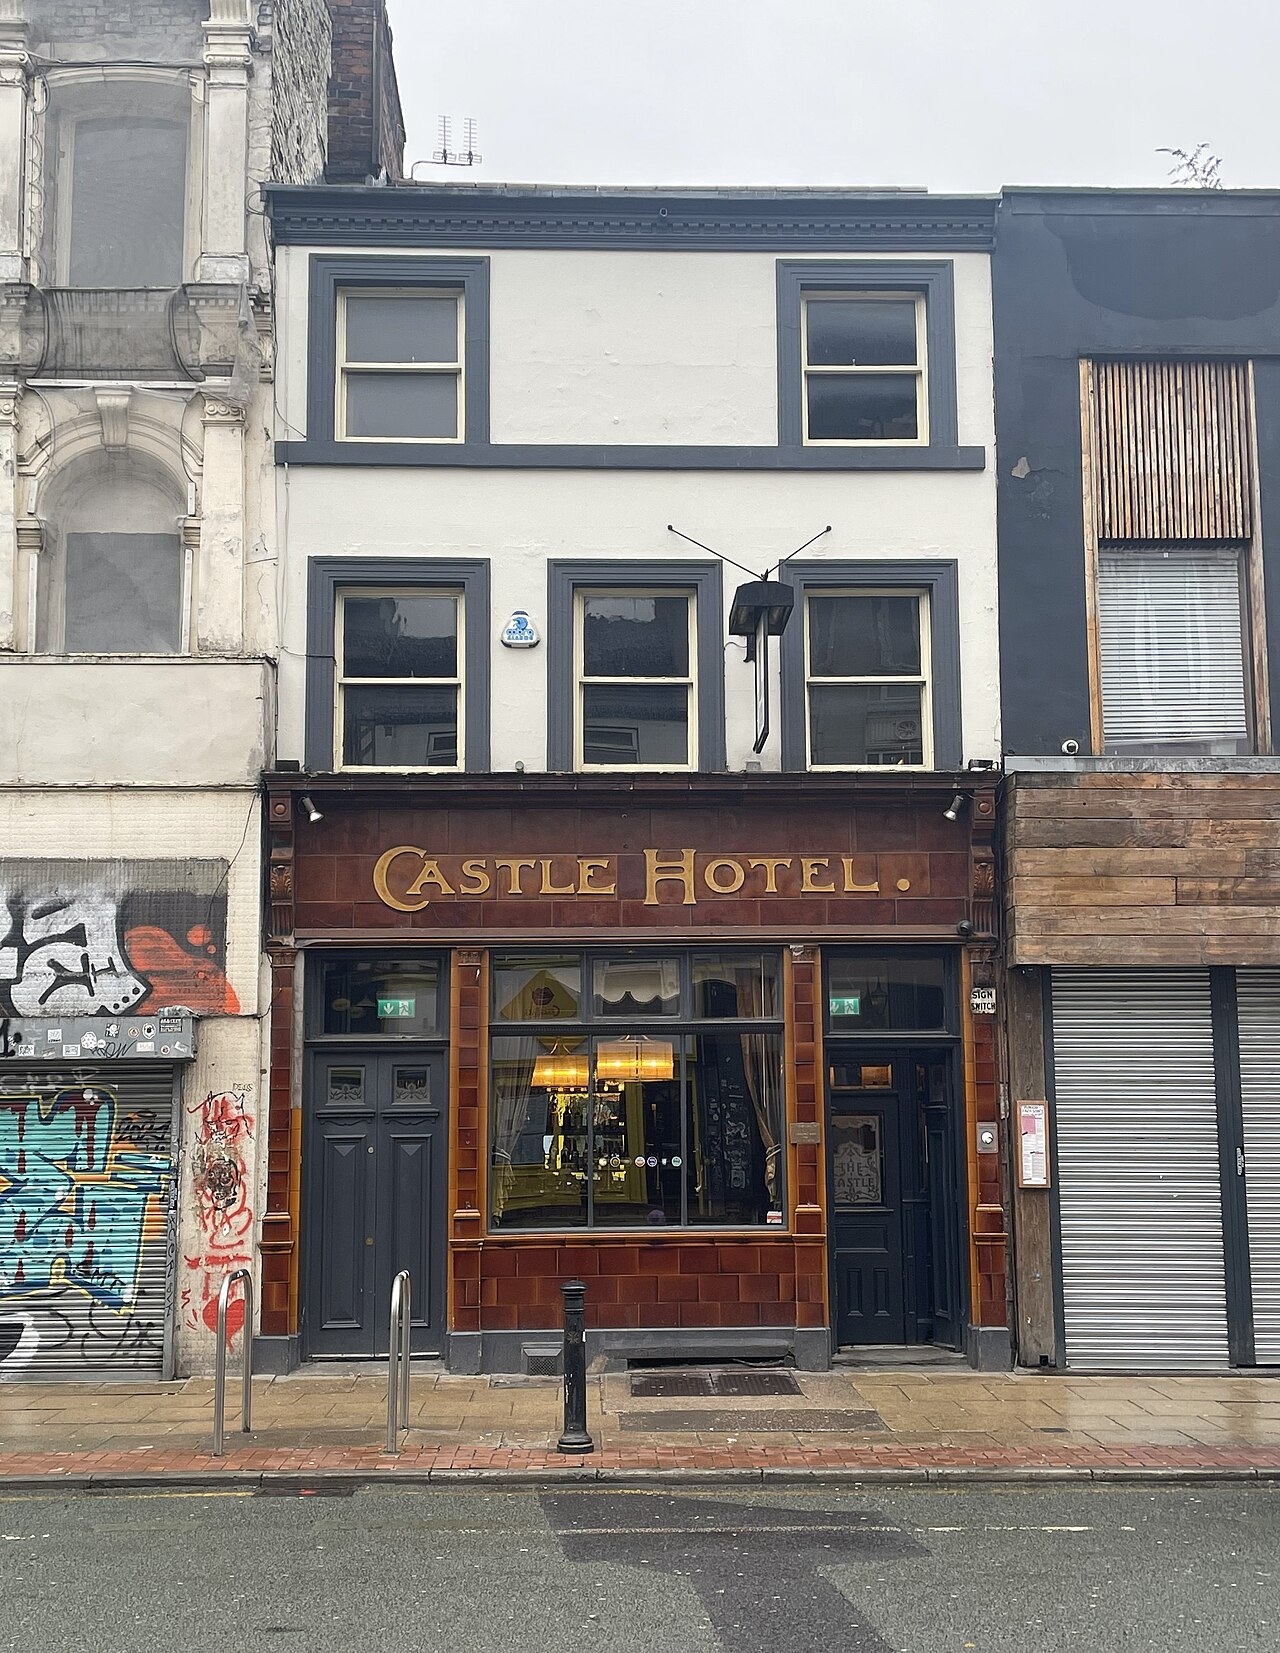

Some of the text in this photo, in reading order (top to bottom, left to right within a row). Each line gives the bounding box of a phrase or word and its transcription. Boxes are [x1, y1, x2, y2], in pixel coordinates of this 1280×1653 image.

[373, 845, 616, 912] CASTLE
[971, 990, 993, 999] SIGN
[971, 1002, 996, 1011] SWITCH
[838, 1162, 865, 1175] THE
[834, 1177, 875, 1188] ASTLE
